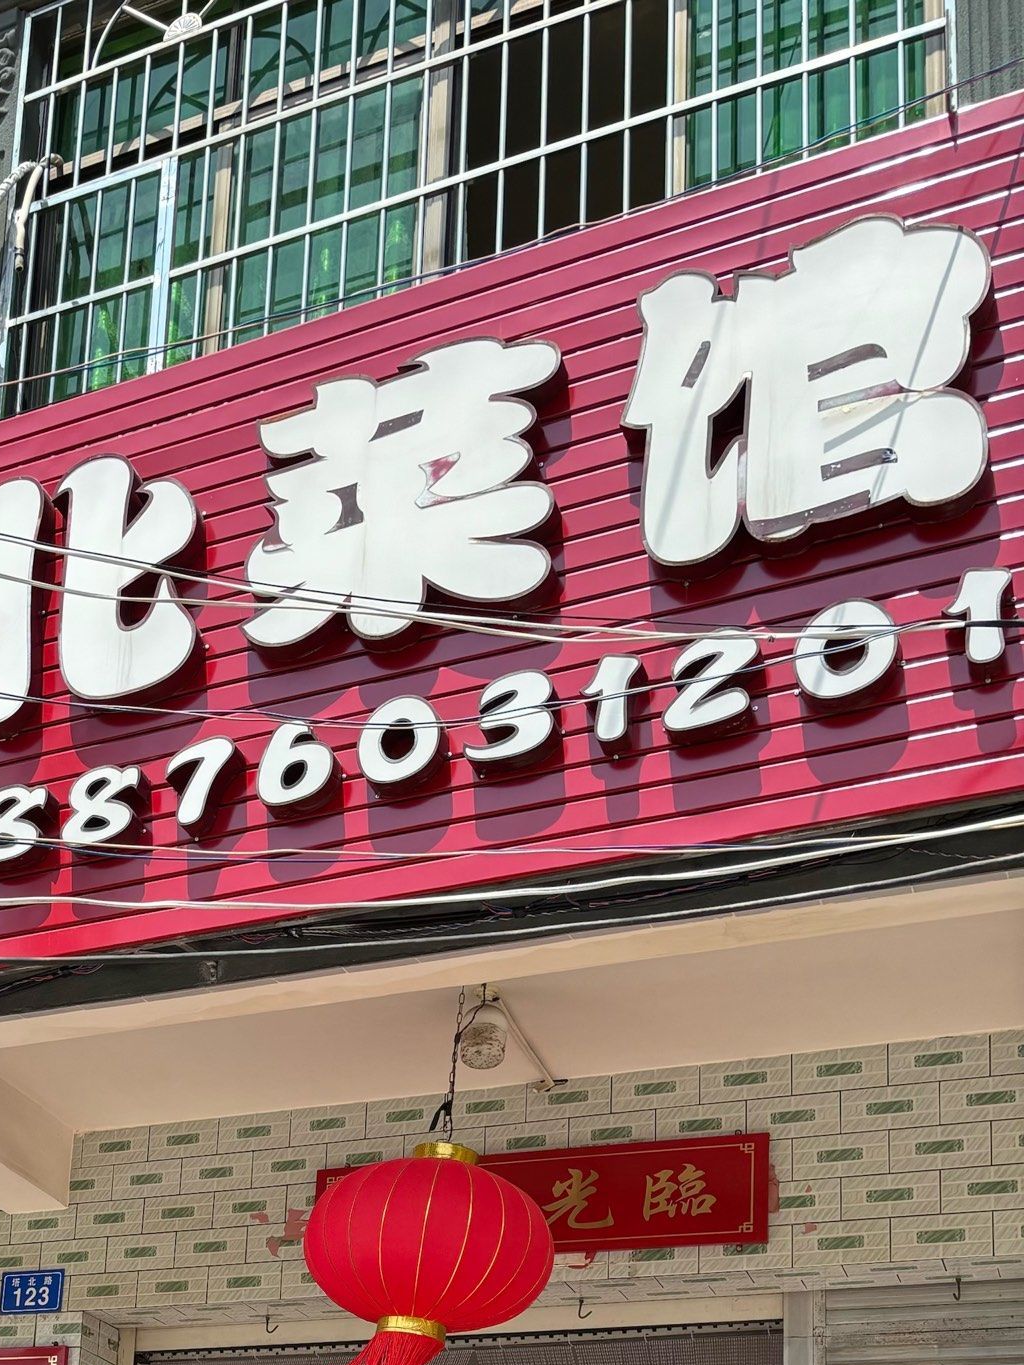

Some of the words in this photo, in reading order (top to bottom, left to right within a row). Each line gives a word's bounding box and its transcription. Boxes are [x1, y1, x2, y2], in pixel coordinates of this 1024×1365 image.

[11, 1276, 53, 1287] 塔北路
[13, 1286, 50, 1307] 123
